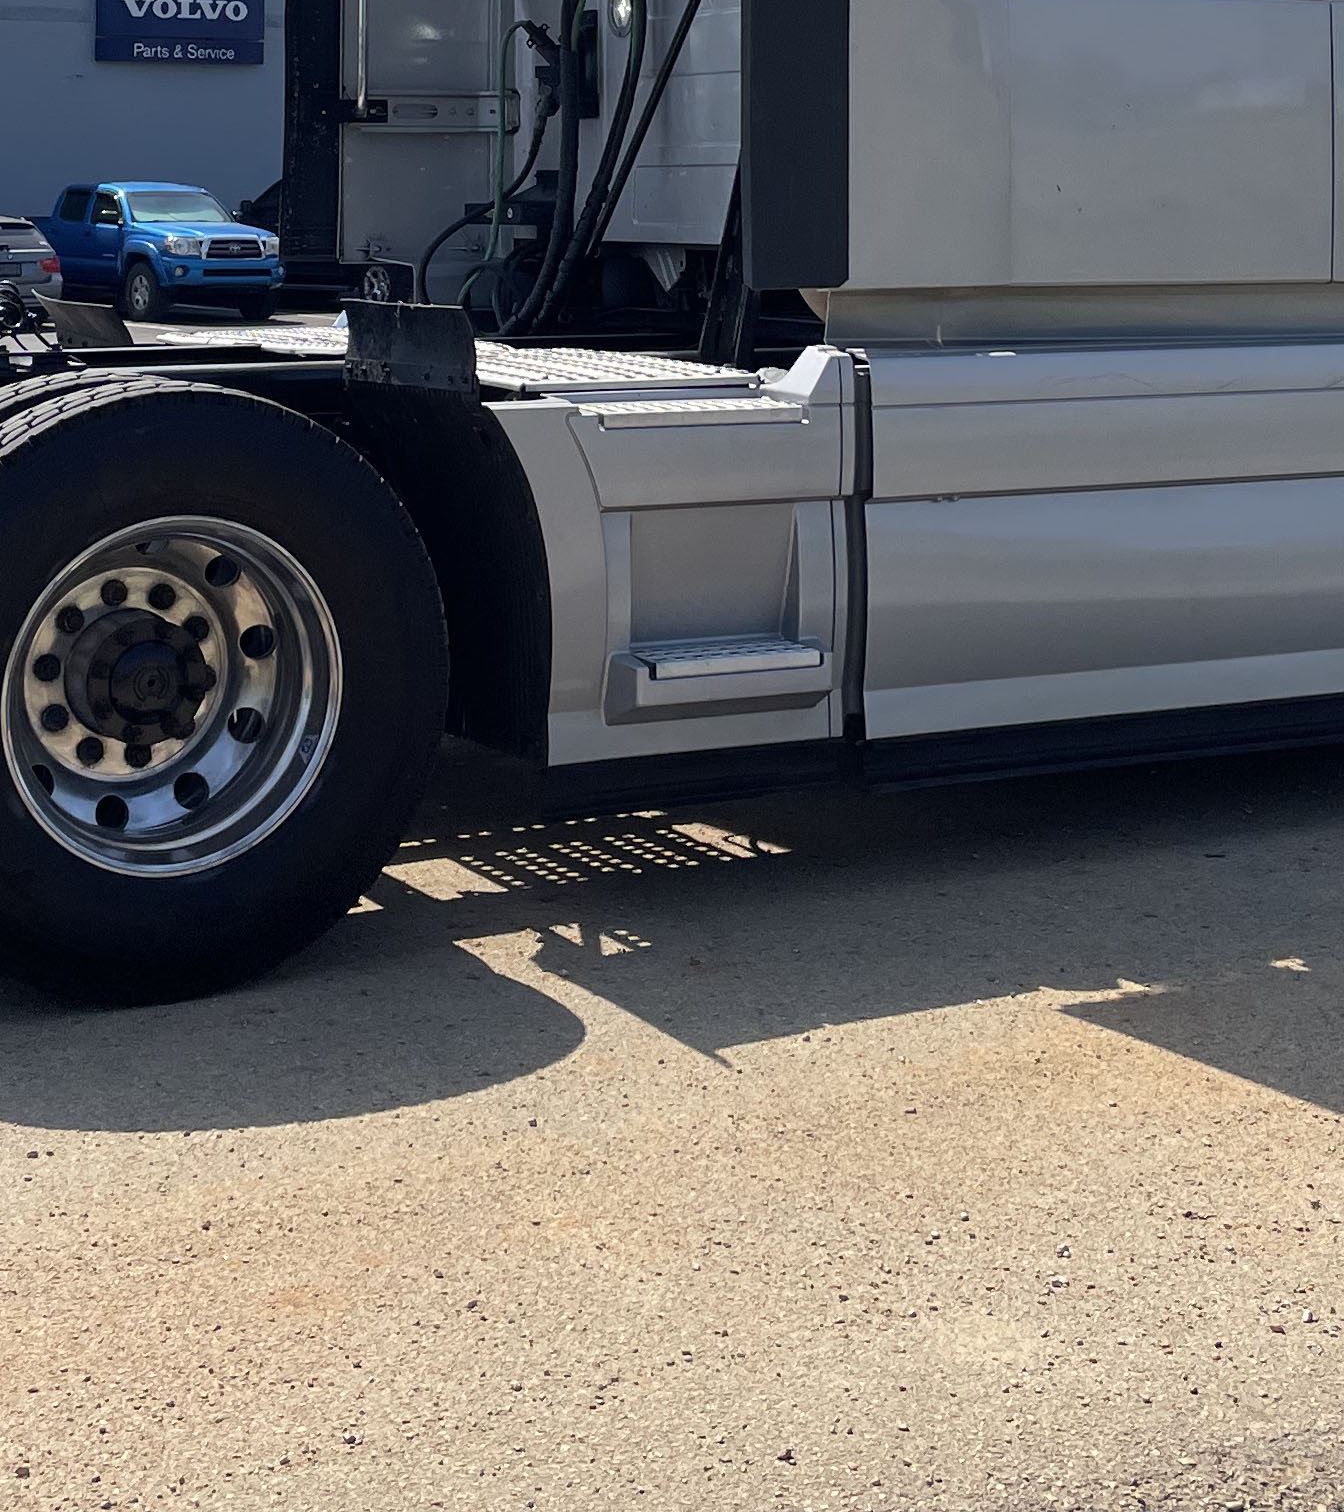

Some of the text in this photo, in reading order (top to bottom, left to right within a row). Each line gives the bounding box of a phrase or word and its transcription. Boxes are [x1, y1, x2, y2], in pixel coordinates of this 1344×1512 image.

[133, 42, 236, 60] Parts & Service
